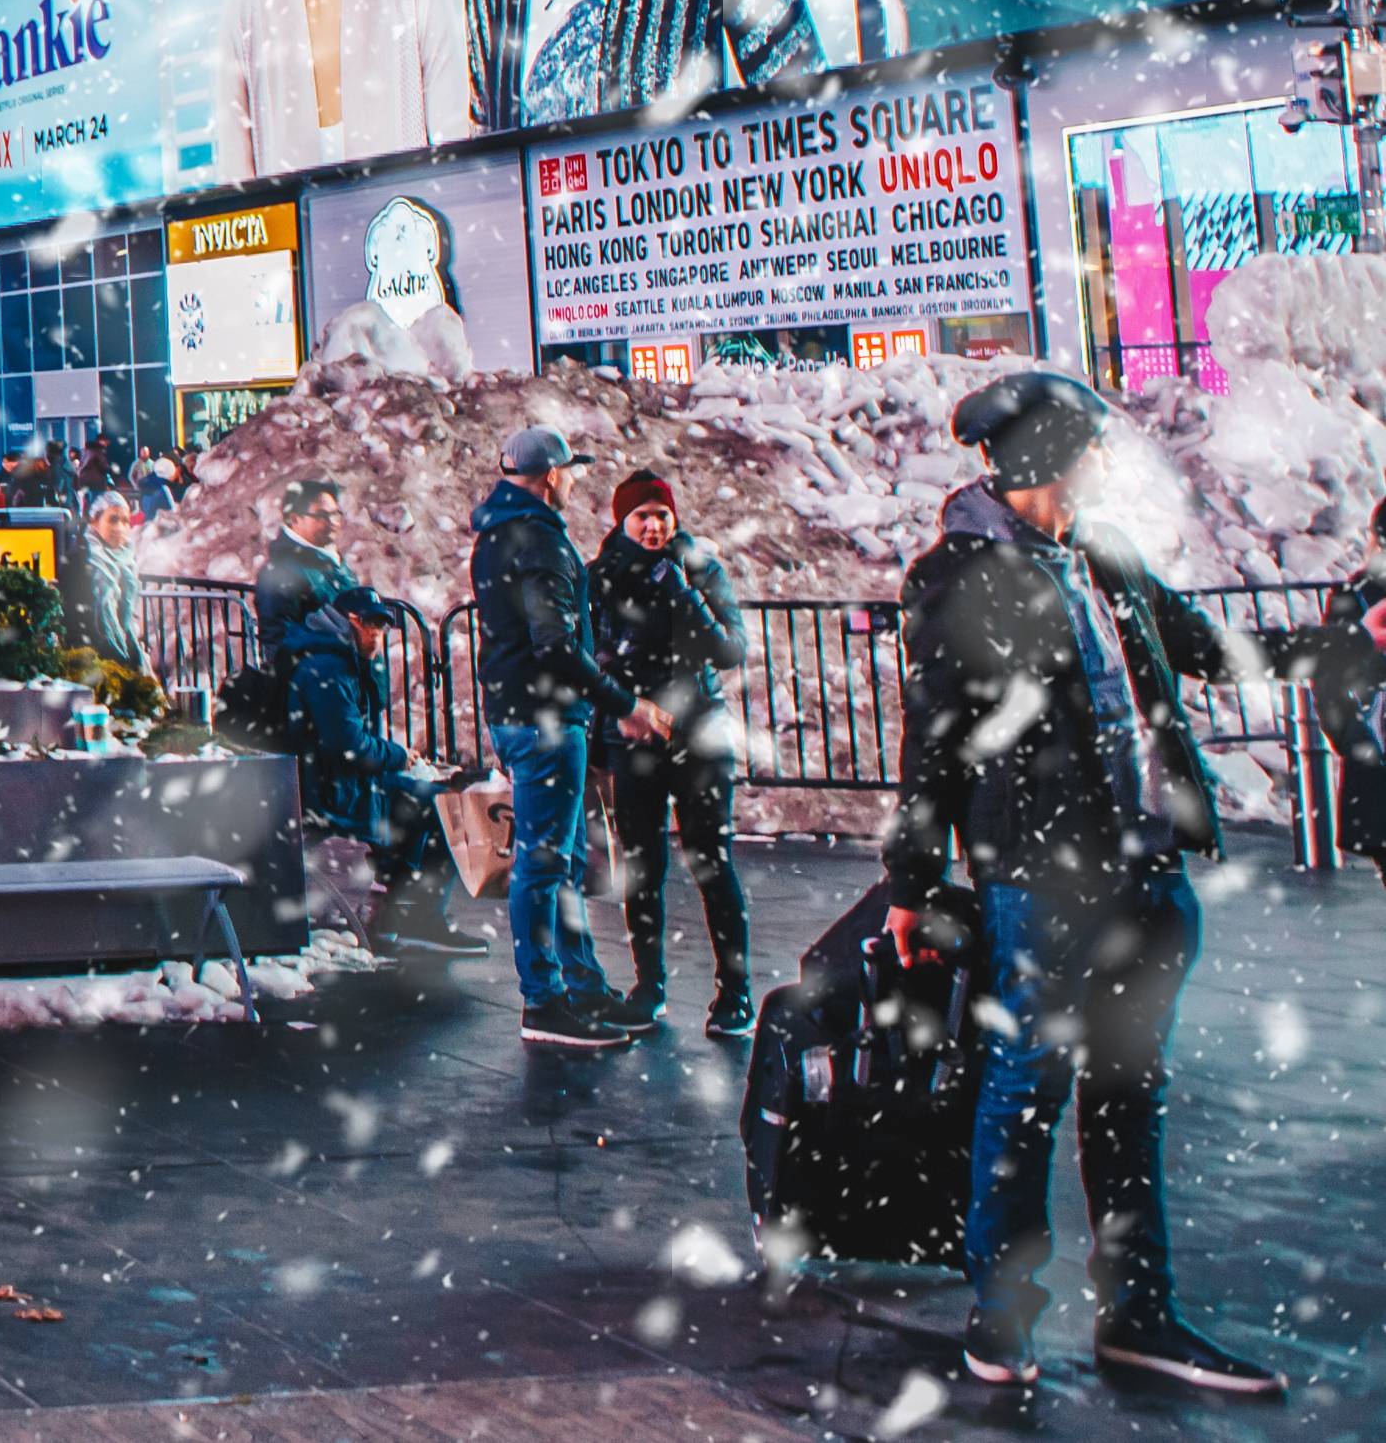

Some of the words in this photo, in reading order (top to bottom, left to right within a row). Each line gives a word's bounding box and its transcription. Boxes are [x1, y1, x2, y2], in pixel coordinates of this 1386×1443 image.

[34, 120, 85, 153] MARCH
[90, 114, 109, 140] 24
[596, 136, 685, 188] TOKYO
[693, 129, 732, 172] TO
[742, 110, 838, 165] TIMES
[850, 84, 996, 152] SQUARE
[542, 197, 607, 237] PARIS
[615, 183, 713, 228] LONDON
[722, 172, 785, 214] NEW
[792, 160, 866, 204] YORK
[879, 142, 999, 194] UNIQLO
[192, 214, 269, 255] INVICTA
[544, 243, 592, 271] HONG
[599, 233, 649, 266] KONG
[656, 222, 752, 259] TORONTO
[760, 206, 878, 248] SHANGHAI
[891, 192, 1005, 234] CHICAGO
[573, 272, 639, 295] ANGELES
[645, 262, 730, 290] SINGAPORE
[891, 234, 1008, 267] MELBOURNE
[548, 303, 609, 323] UNIQLO.COM
[614, 298, 666, 318] SEATTLE
[671, 295, 712, 313] KUALA
[714, 289, 765, 309] LUMPUR
[771, 285, 826, 304] MOSCOW
[833, 279, 888, 300] MANILA
[894, 276, 923, 296] SAN
[926, 269, 1011, 292] FRANCISCO
[802, 309, 868, 322] PHILADELPHIA
[871, 305, 914, 318] BANGKOK
